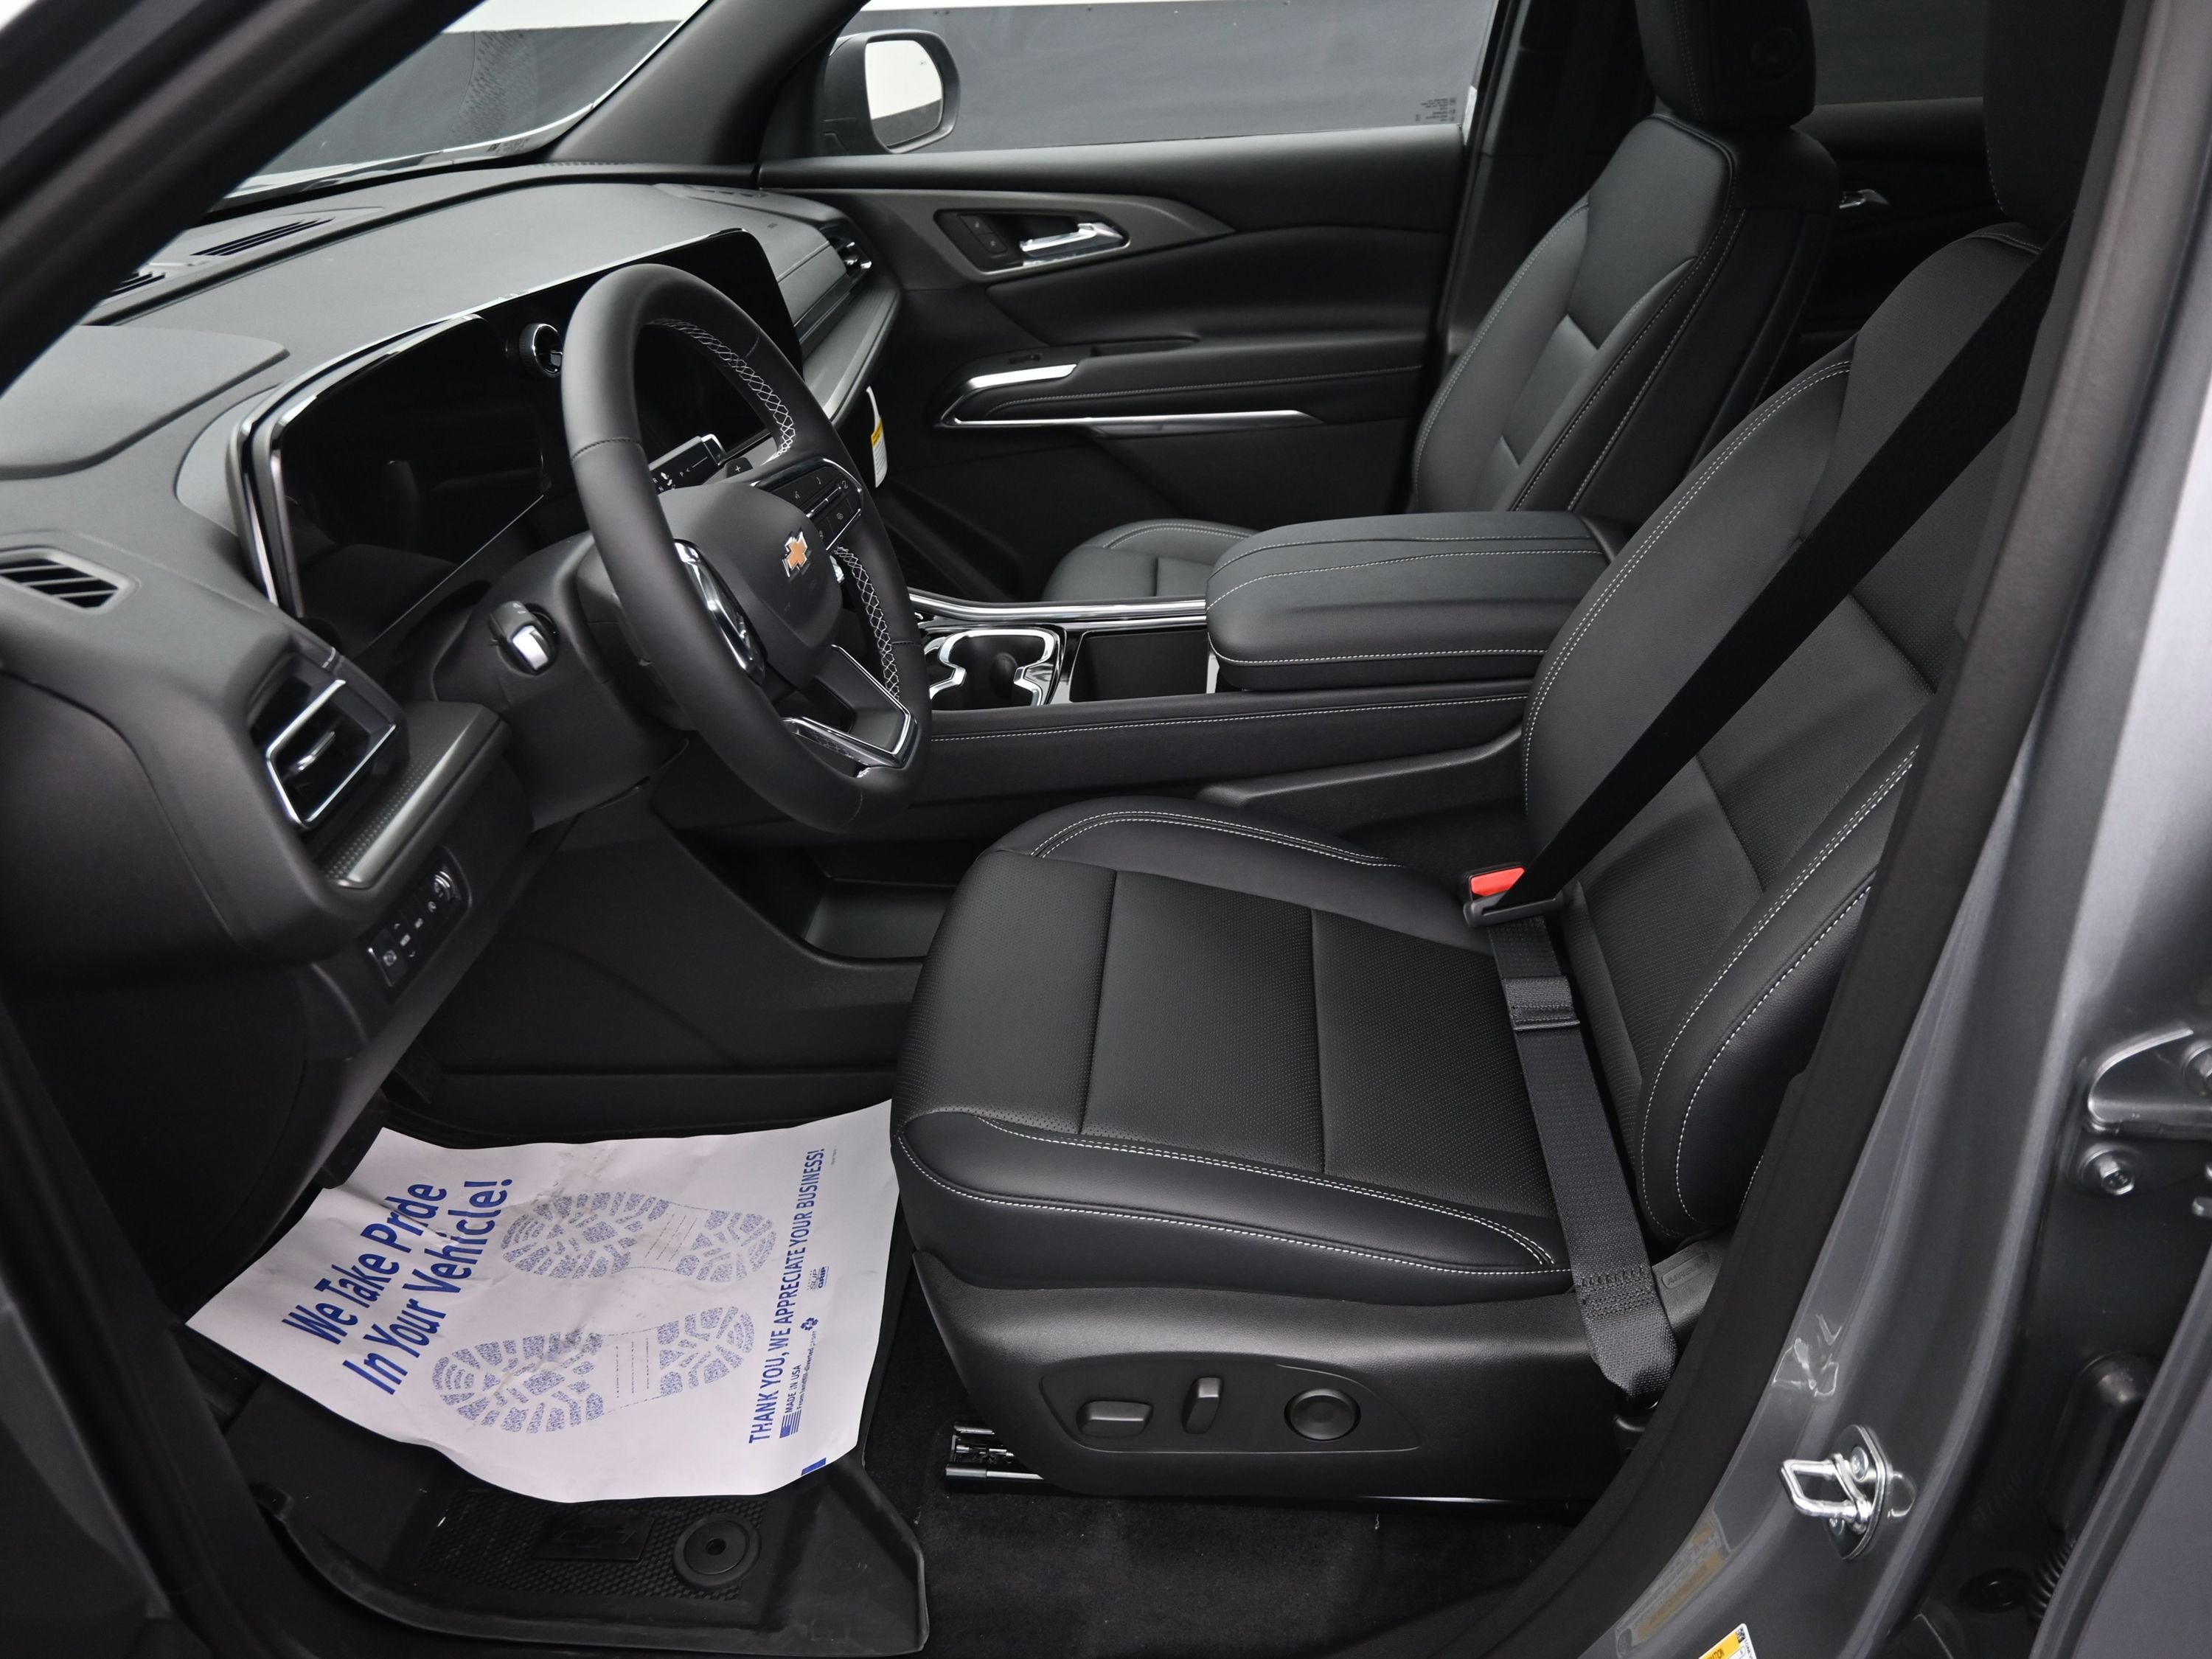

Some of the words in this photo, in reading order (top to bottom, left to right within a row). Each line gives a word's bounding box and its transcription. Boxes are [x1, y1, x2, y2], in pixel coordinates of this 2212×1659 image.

[796, 1148, 825, 1209] BUSINESS!
[402, 1179, 512, 1293] Vehicle!
[788, 1211, 813, 1248] YOUR
[314, 1253, 400, 1308] Take
[773, 1247, 806, 1324] APPRECIATE
[818, 1266, 827, 1289] GRIP
[281, 1303, 358, 1345] We
[362, 1298, 446, 1358] Your
[768, 1327, 791, 1352] WE
[342, 1352, 408, 1395] In
[759, 1352, 790, 1388] YOU,
[790, 1380, 799, 1391] IN
[792, 1364, 801, 1379] USA
[748, 1390, 779, 1444] THANK
[785, 1391, 796, 1413] MADE
[796, 1393, 805, 1410] From
